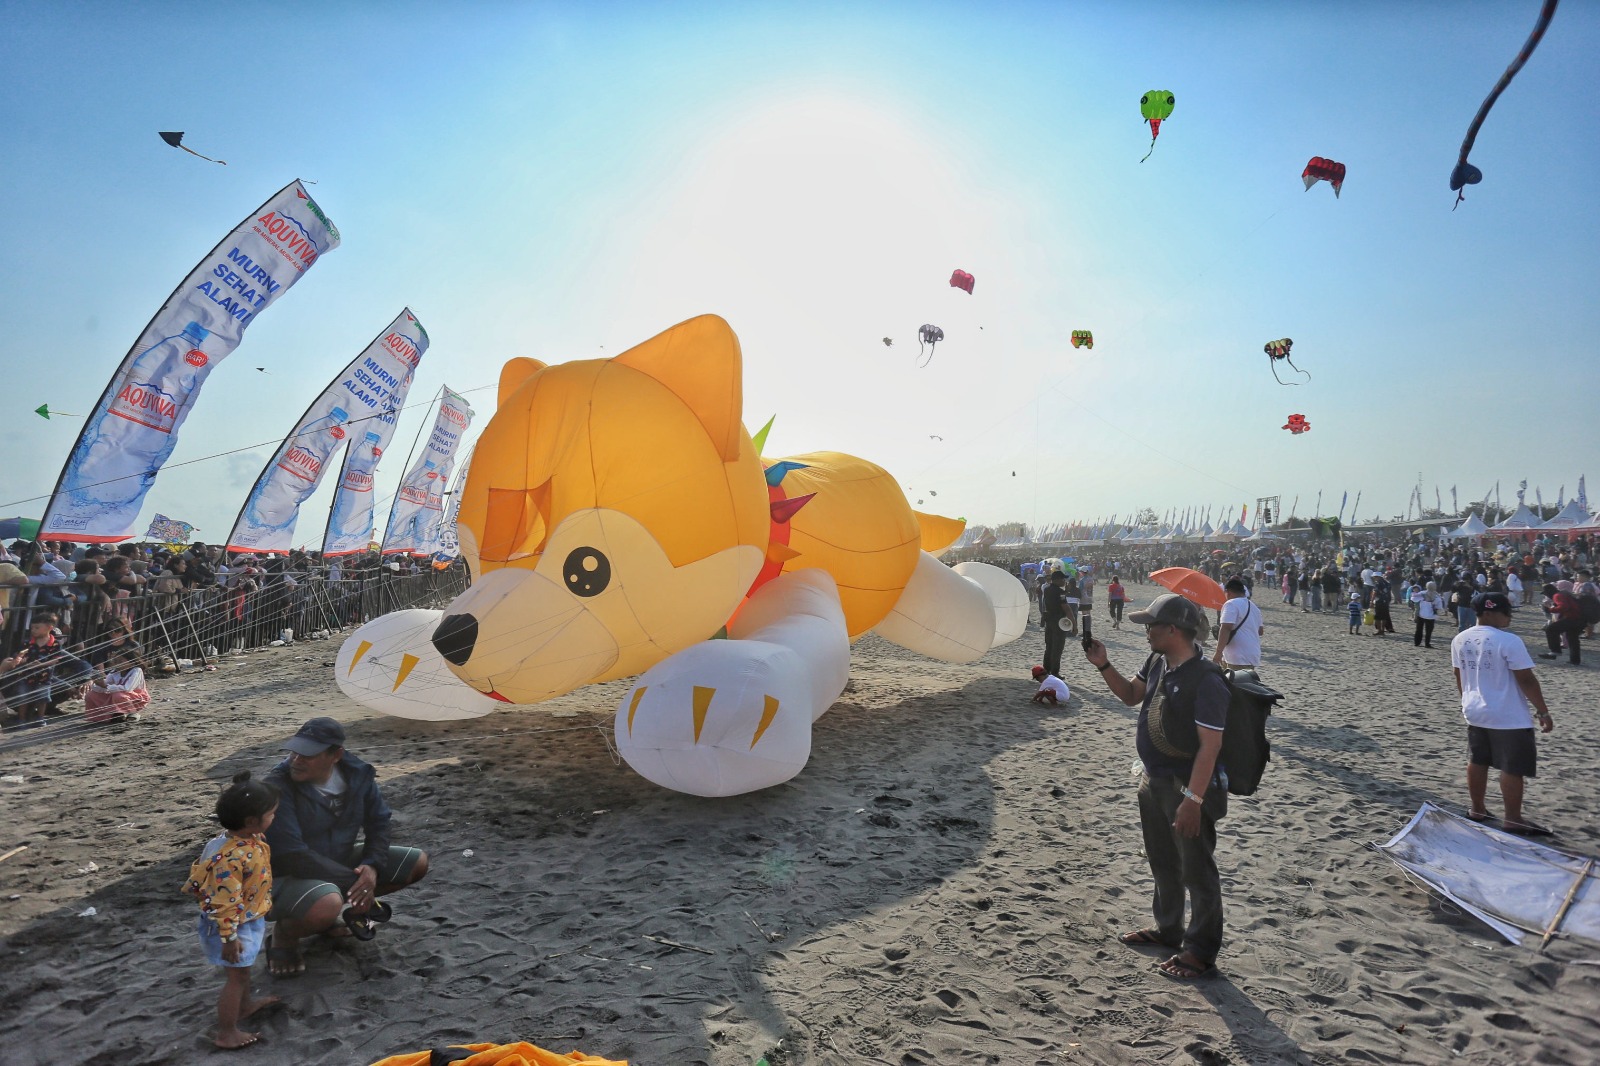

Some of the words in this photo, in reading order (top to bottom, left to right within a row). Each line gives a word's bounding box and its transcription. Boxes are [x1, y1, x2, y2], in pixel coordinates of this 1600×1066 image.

[257, 211, 318, 267] AQUVIVA
[213, 263, 266, 308] SEHAT
[227, 247, 281, 294] MURNI
[196, 280, 253, 323] ALAMI
[384, 332, 420, 368] AQUVIVA
[353, 368, 389, 398] SEHAT
[363, 357, 399, 389] MURNI
[117, 384, 176, 420] AQUVIVA
[342, 379, 378, 409] ALAMI
[432, 433, 454, 448] SEHAT
[435, 424, 458, 440] MURNI
[285, 447, 321, 474] AQUVIVA
[428, 442, 450, 456] ALAMI
